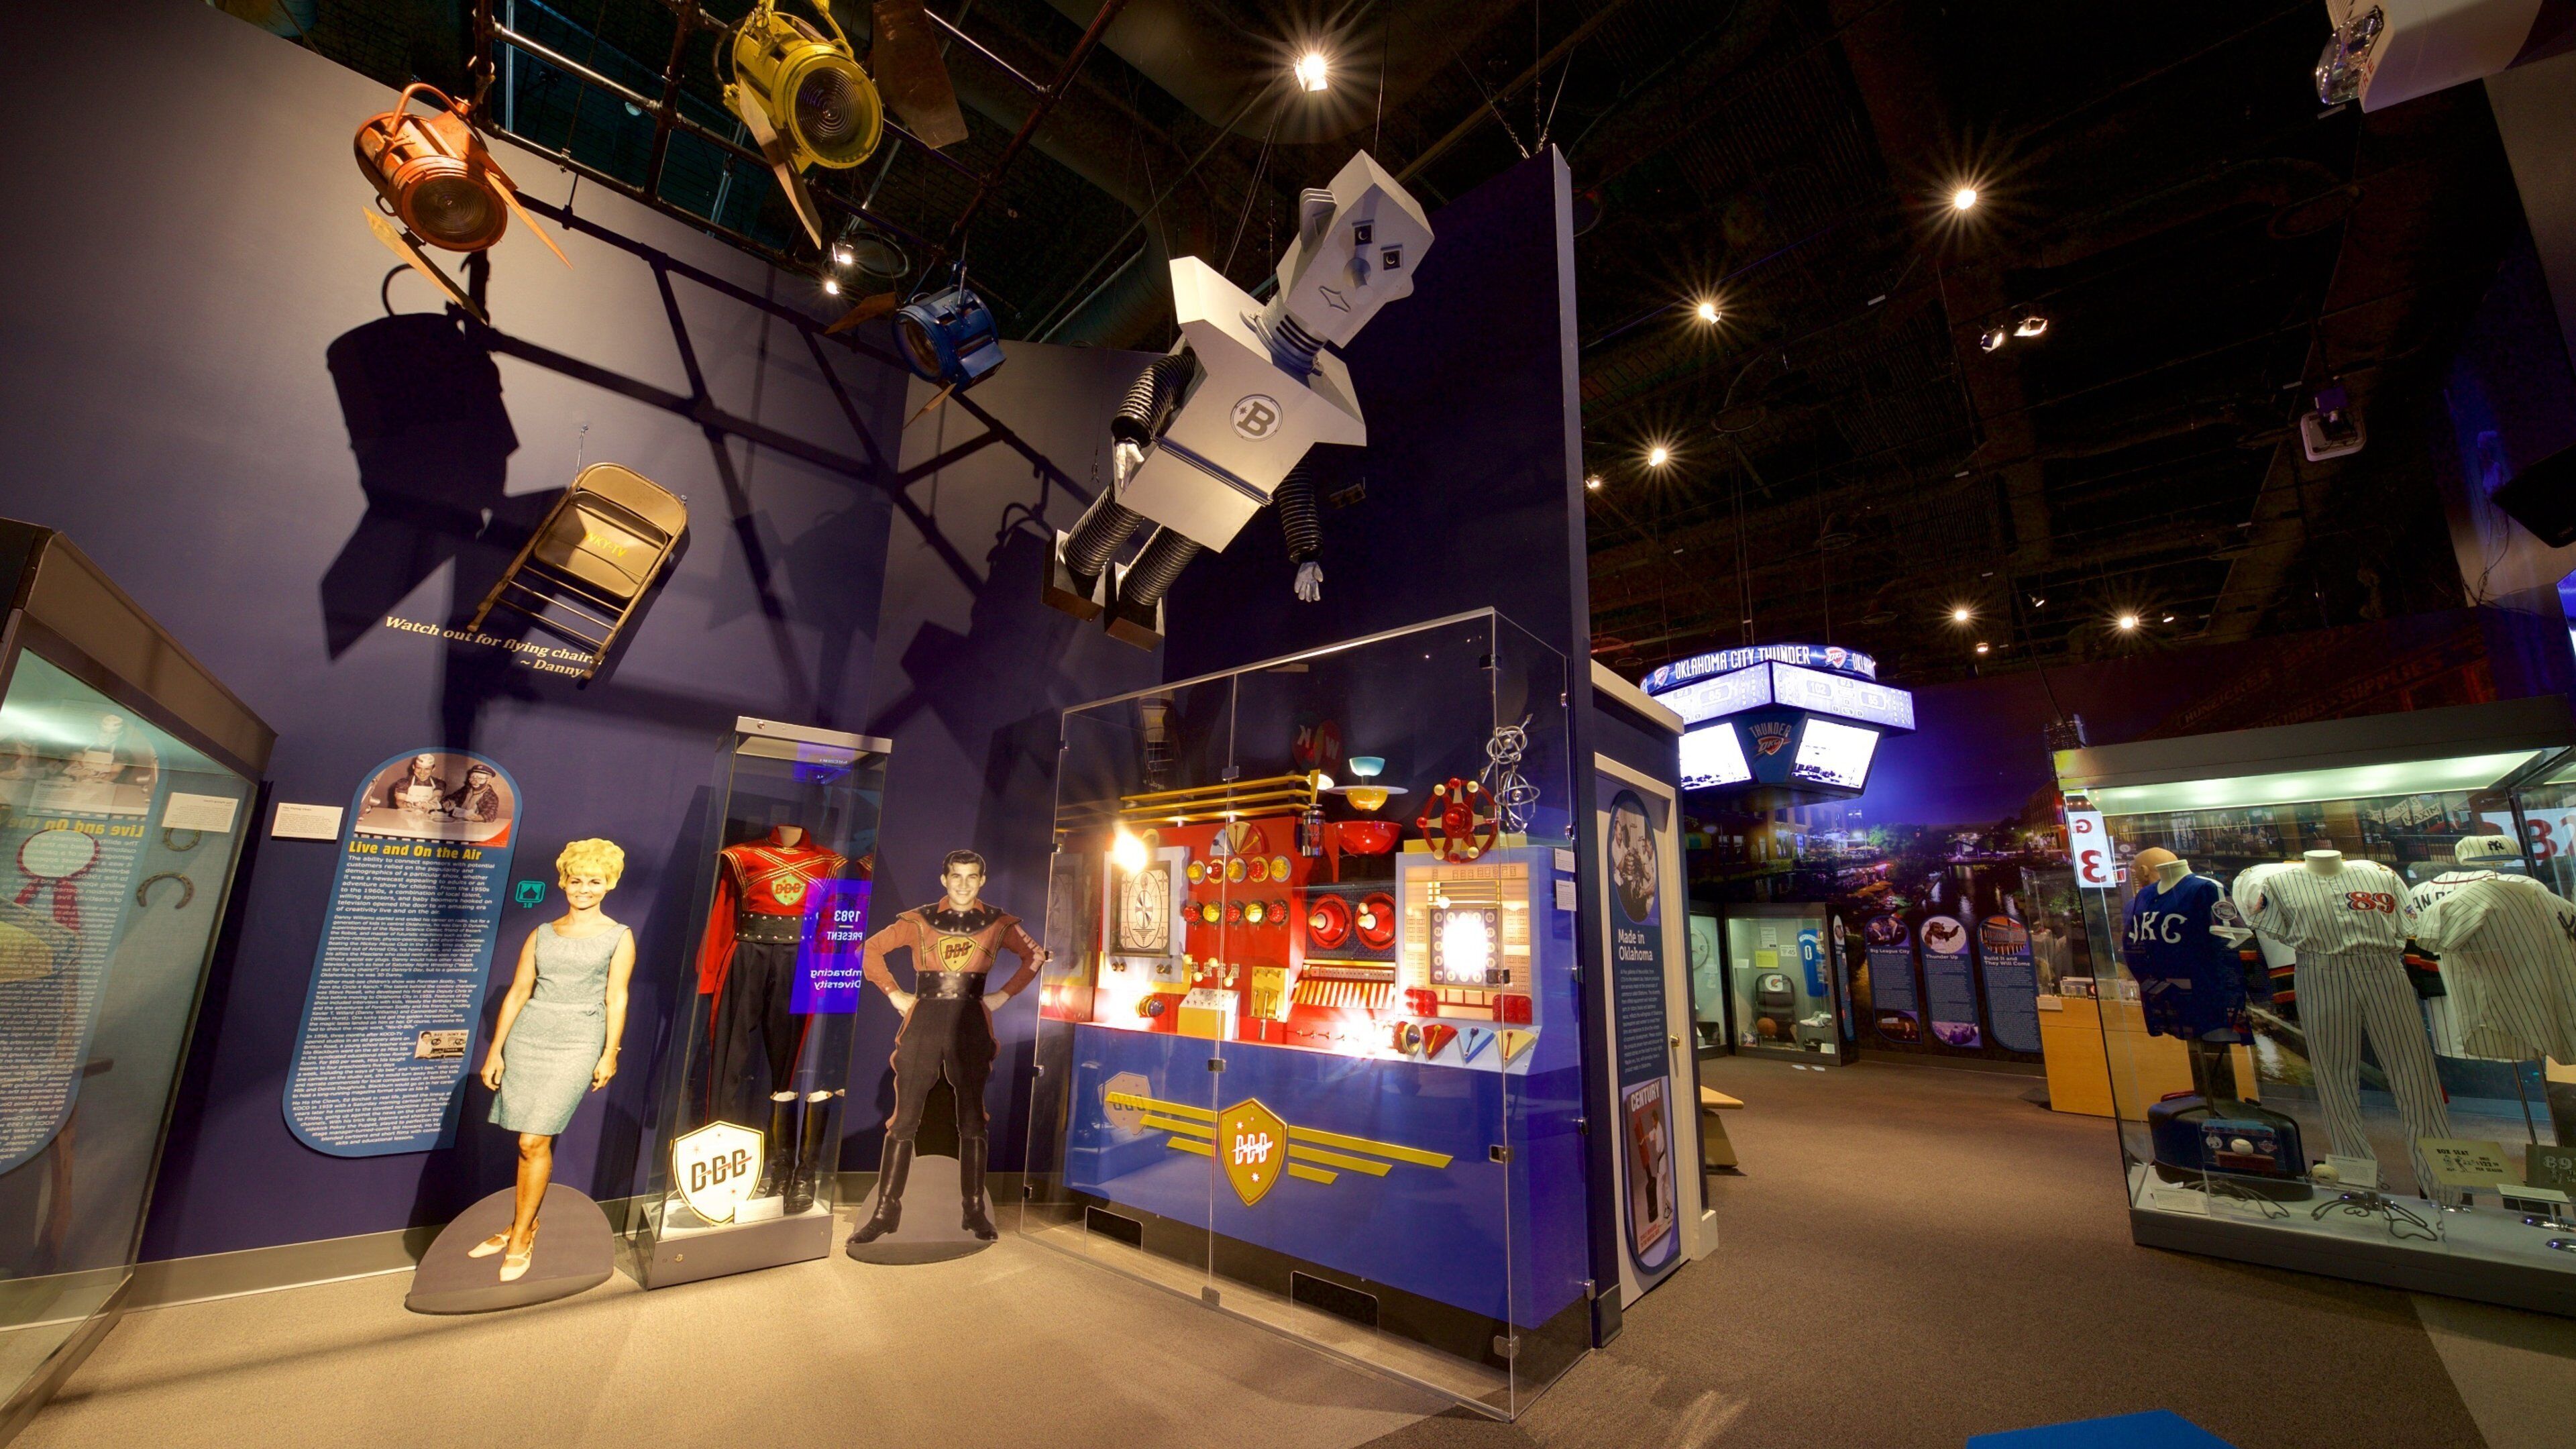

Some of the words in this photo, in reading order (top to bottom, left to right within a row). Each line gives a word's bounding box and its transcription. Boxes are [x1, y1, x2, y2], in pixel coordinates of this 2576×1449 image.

[1238, 400, 1275, 436] B
[585, 532, 628, 557] WKY-TV
[384, 616, 440, 636] Watch
[443, 628, 474, 642] out
[473, 633, 502, 648] for
[502, 639, 551, 659] flying
[533, 659, 585, 678] Danny
[1675, 653, 1727, 680] OKLAHOMA
[1730, 647, 1756, 669] CITY
[1758, 645, 1811, 665] THUNDER
[1749, 722, 1792, 738] THUNDER
[349, 841, 379, 855] Live
[382, 845, 409, 856] and
[413, 845, 431, 858] On
[437, 847, 458, 859] the
[463, 848, 482, 860] Air
[345, 868, 393, 876] demographics
[2346, 891, 2396, 914] 89
[1618, 928, 1636, 944] Made
[1638, 930, 1645, 945] in
[1619, 946, 1653, 961] Oklahoma
[1804, 945, 1813, 960] 0
[1764, 975, 1783, 991] G
[1631, 1081, 1660, 1112] CENTURY
